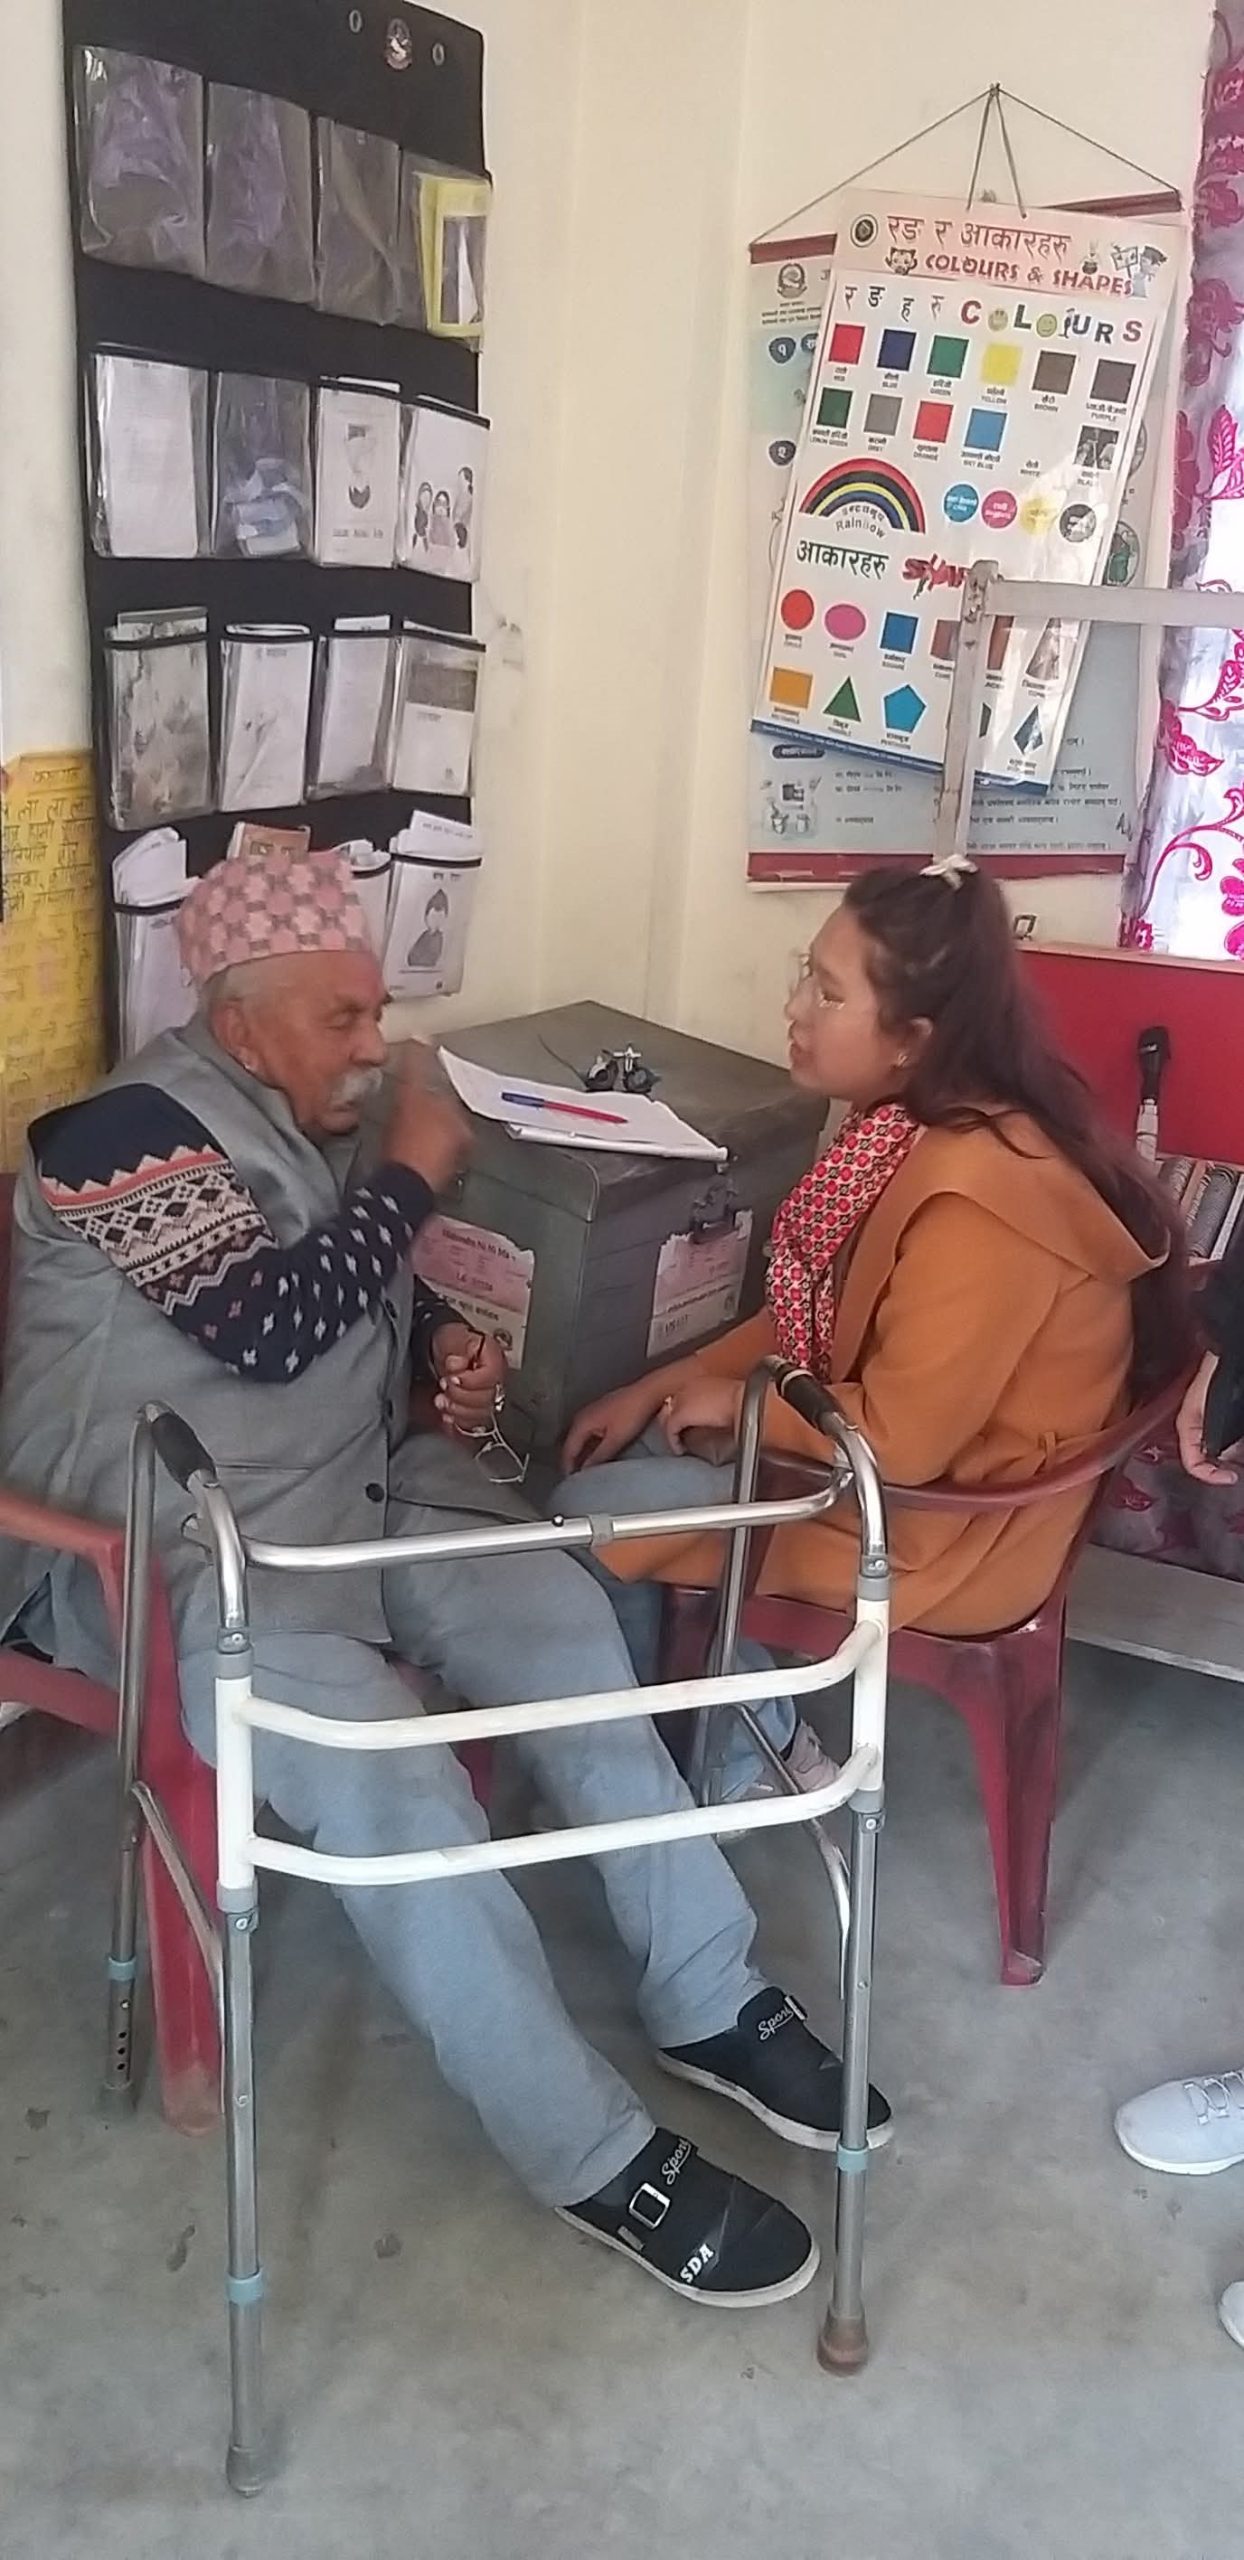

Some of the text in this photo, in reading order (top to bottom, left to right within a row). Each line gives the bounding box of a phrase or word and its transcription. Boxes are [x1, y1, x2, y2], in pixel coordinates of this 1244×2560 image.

[926, 254, 1132, 296] COLOURS & SHAPES
[680, 2243, 715, 2284] SDA
